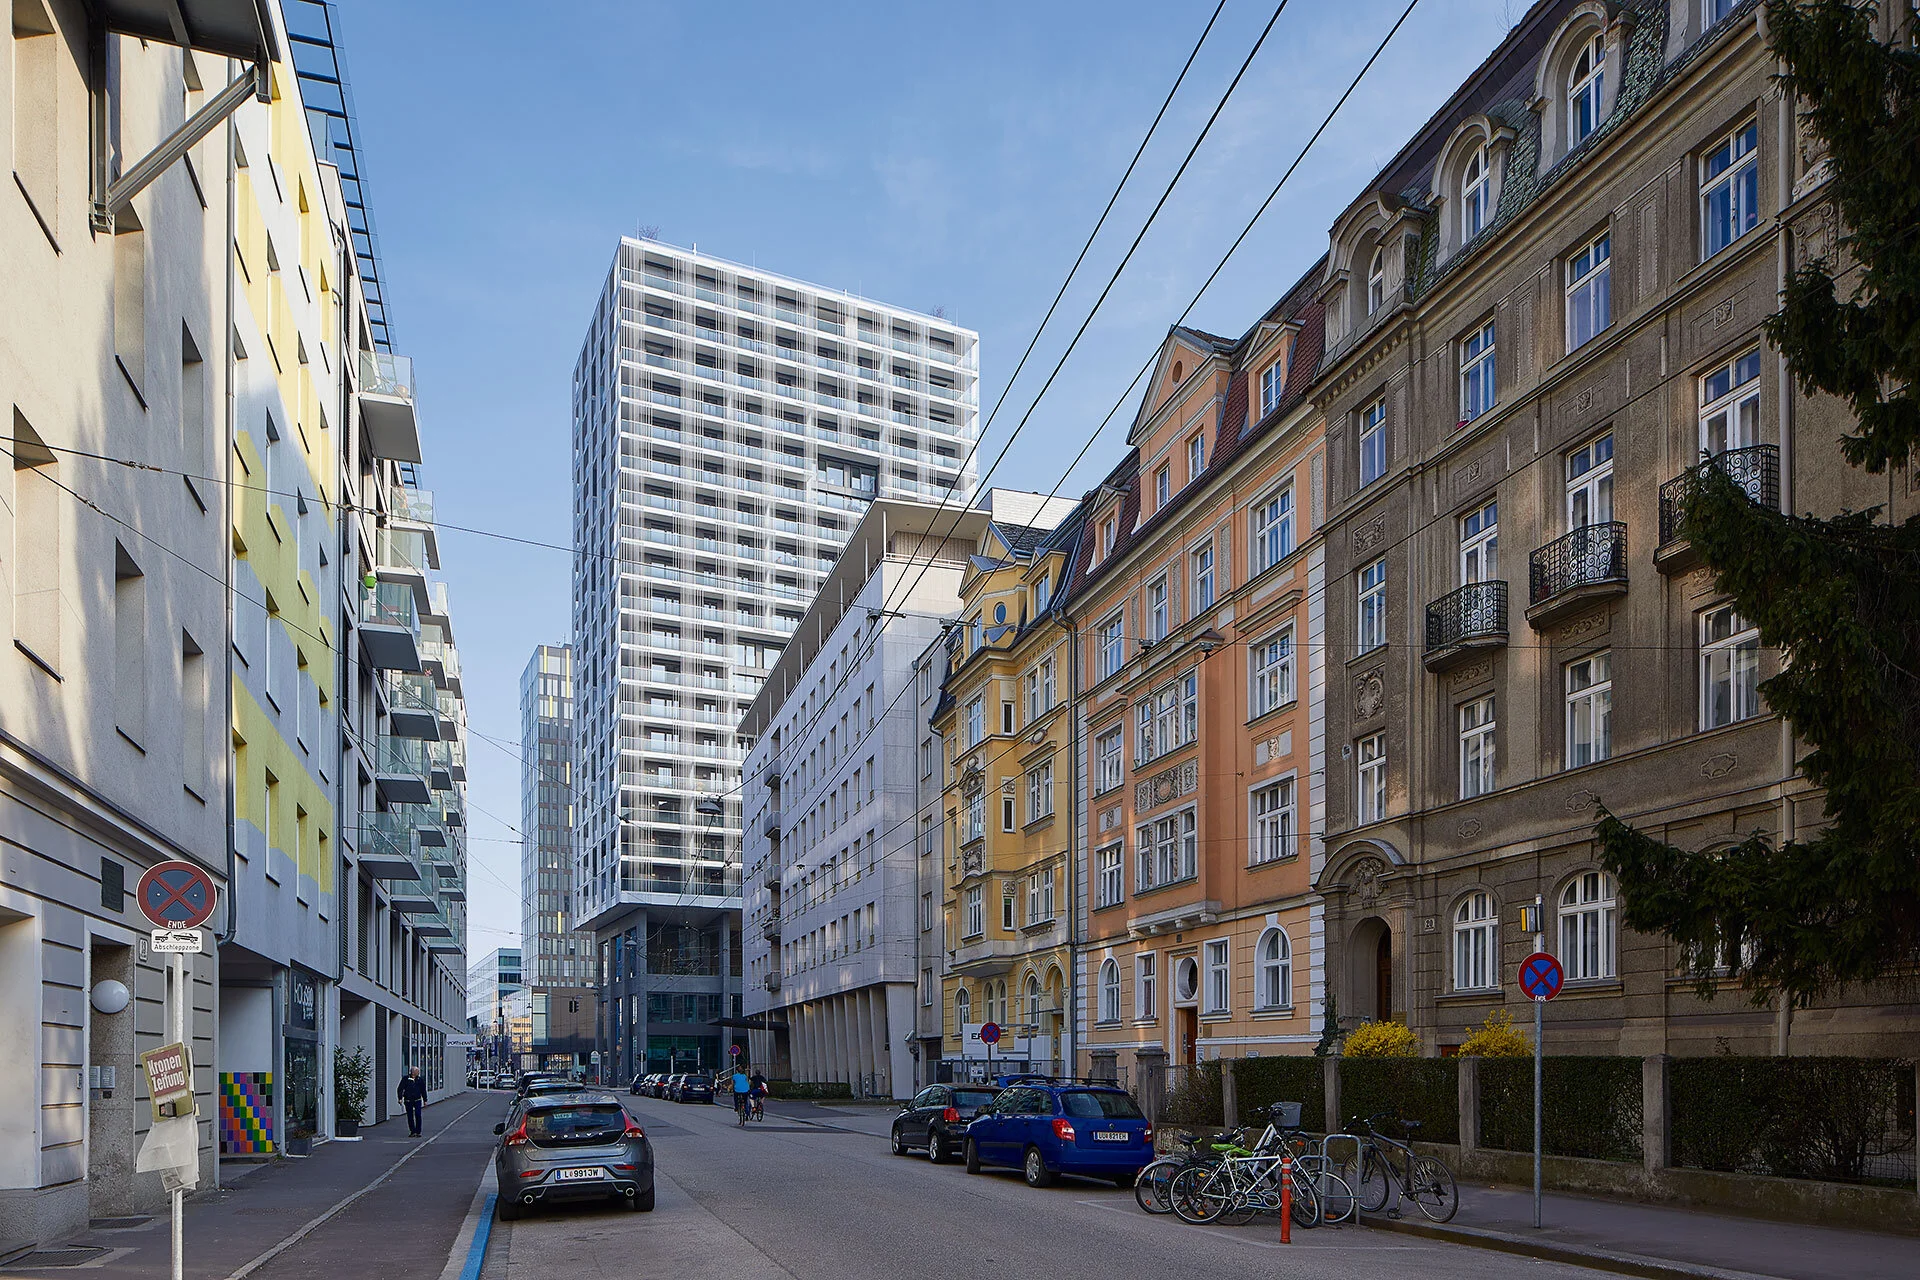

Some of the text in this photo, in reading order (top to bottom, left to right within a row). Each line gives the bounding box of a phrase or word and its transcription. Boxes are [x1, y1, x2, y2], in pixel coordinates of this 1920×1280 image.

[167, 920, 187, 929] ENDE
[154, 943, 199, 951] Abschleppzone
[147, 1054, 182, 1076] Kronen
[151, 1070, 185, 1092] Zeitung
